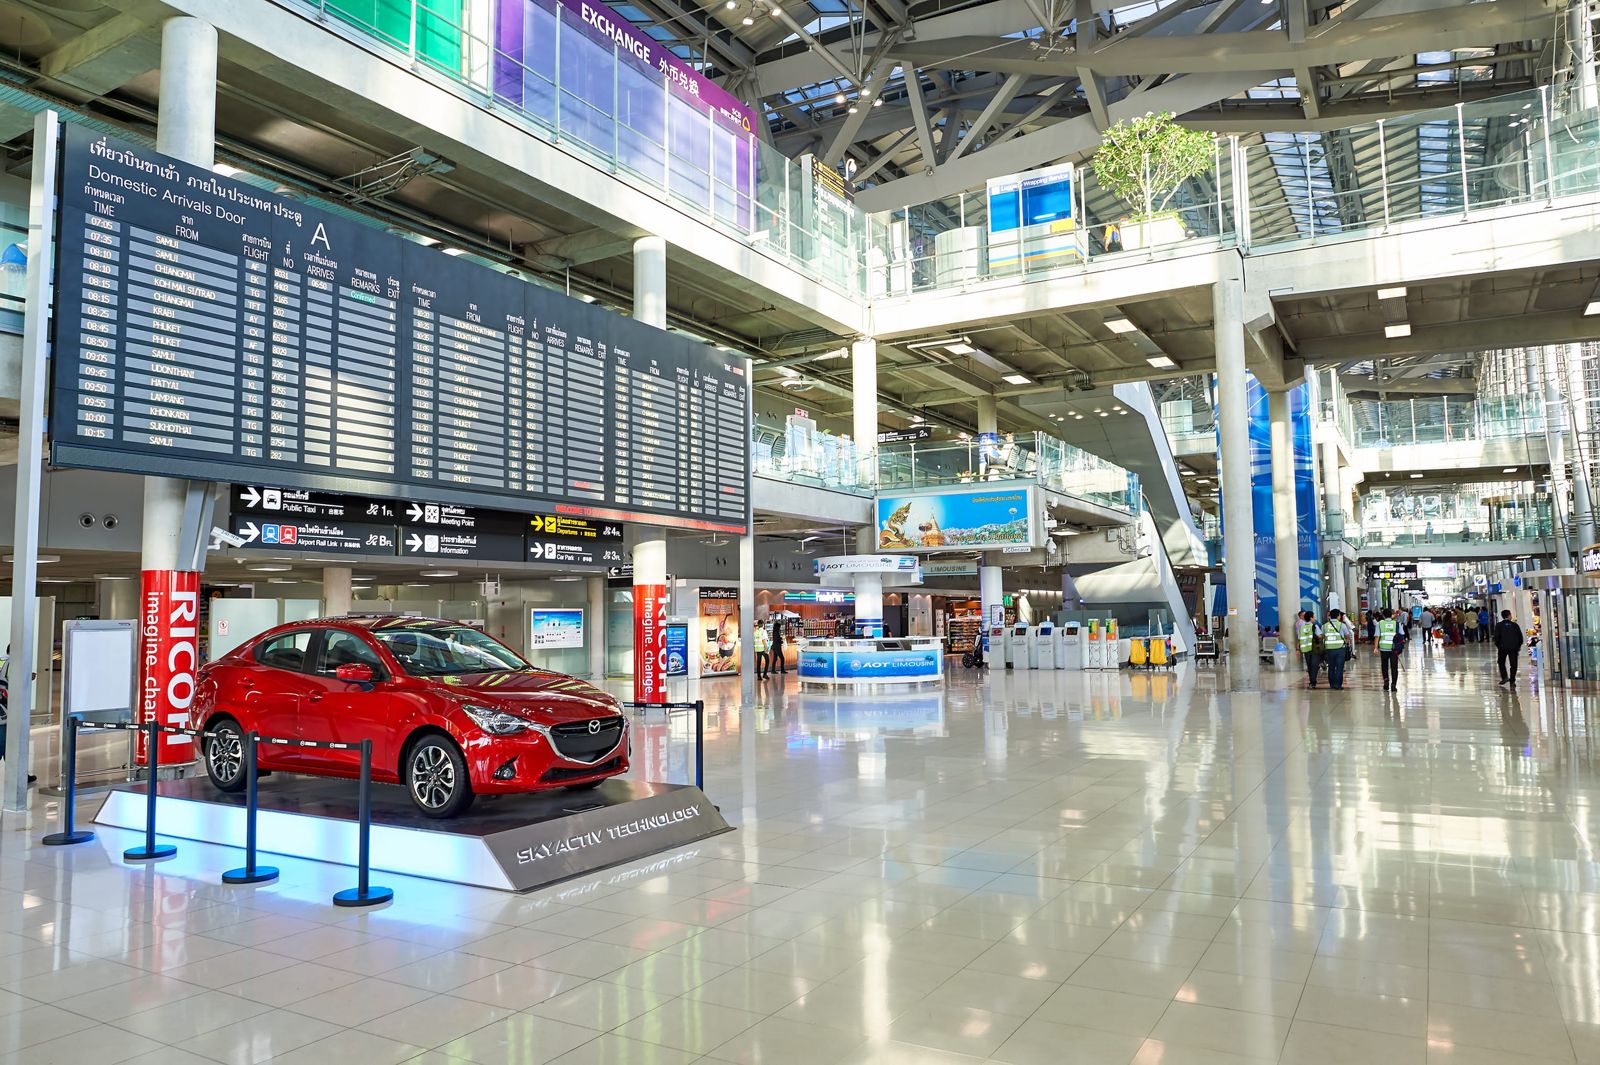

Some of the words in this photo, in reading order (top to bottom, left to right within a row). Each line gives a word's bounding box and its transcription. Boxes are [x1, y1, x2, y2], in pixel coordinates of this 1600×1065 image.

[582, 3, 650, 65] EXCHANGE
[659, 57, 700, 98] 外币兑换
[89, 137, 180, 183] เที่ยวบินขาเข้า
[89, 165, 157, 198] Domestic
[162, 191, 212, 216] Arrivals
[216, 206, 246, 226] Door
[91, 218, 112, 229] 07:05
[156, 236, 179, 248] SAMUI
[91, 232, 112, 244] 07:35
[156, 250, 179, 262] SAMUI
[311, 223, 330, 250] A
[93, 201, 114, 217] TIME
[176, 225, 199, 241] FROM
[244, 246, 269, 261] FLIGHT
[283, 258, 294, 269] NO
[307, 265, 334, 280] ARRIVES
[352, 278, 380, 294] REMARKS
[388, 289, 400, 299] EXIT
[90, 247, 111, 259] 08:10
[155, 265, 195, 280] CHIANGMAI
[250, 289, 260, 297] TG
[90, 262, 111, 274] 08:10
[154, 279, 171, 289] KOH
[172, 282, 186, 292] MAI
[249, 302, 260, 310] TFT
[88, 292, 110, 303] 08:15
[153, 307, 175, 318] KRABI
[89, 277, 110, 288] 08:15
[154, 293, 194, 309] CHIANGMAI
[87, 322, 108, 332] 08:45
[152, 336, 181, 348] PHUKET
[88, 307, 109, 317] 08:25
[153, 321, 181, 333] PHUKET
[418, 298, 430, 308] TIME
[467, 312, 480, 322] FROM
[508, 324, 524, 335] FLIGHT
[532, 331, 539, 340] NO
[547, 336, 564, 348] ARRIVES
[575, 344, 594, 356] REMARKS
[87, 337, 108, 348] 08:50
[152, 350, 175, 360] SAMUI
[86, 352, 107, 362] 09:05
[152, 364, 194, 378] UDONTHANI
[85, 382, 106, 392] 09:50
[151, 393, 184, 405] LAMPANG
[86, 367, 107, 377] 09:45
[151, 379, 179, 390] HATYAI
[247, 395, 257, 403] TG
[85, 397, 106, 407] 09:55
[150, 408, 189, 420] KHONKAEN
[85, 413, 105, 423] 10:00
[150, 422, 192, 434] SUKHOTHAI
[84, 428, 105, 438] 10:15
[150, 437, 173, 447] SAMUI
[283, 504, 302, 512] Public
[441, 518, 460, 526] Meeting
[557, 528, 578, 536] Departures
[846, 561, 892, 569] LIMOUSINE
[708, 590, 730, 598] FamilyMart
[816, 592, 844, 604] FamilyMart
[144, 591, 164, 671] imagine.
[642, 598, 655, 648] imagine.
[167, 591, 197, 745] RICOH
[642, 650, 655, 696] change.
[143, 677, 161, 751] chane.
[517, 829, 603, 864] SKYACTIV
[606, 805, 702, 840] TECHNOLOGY
